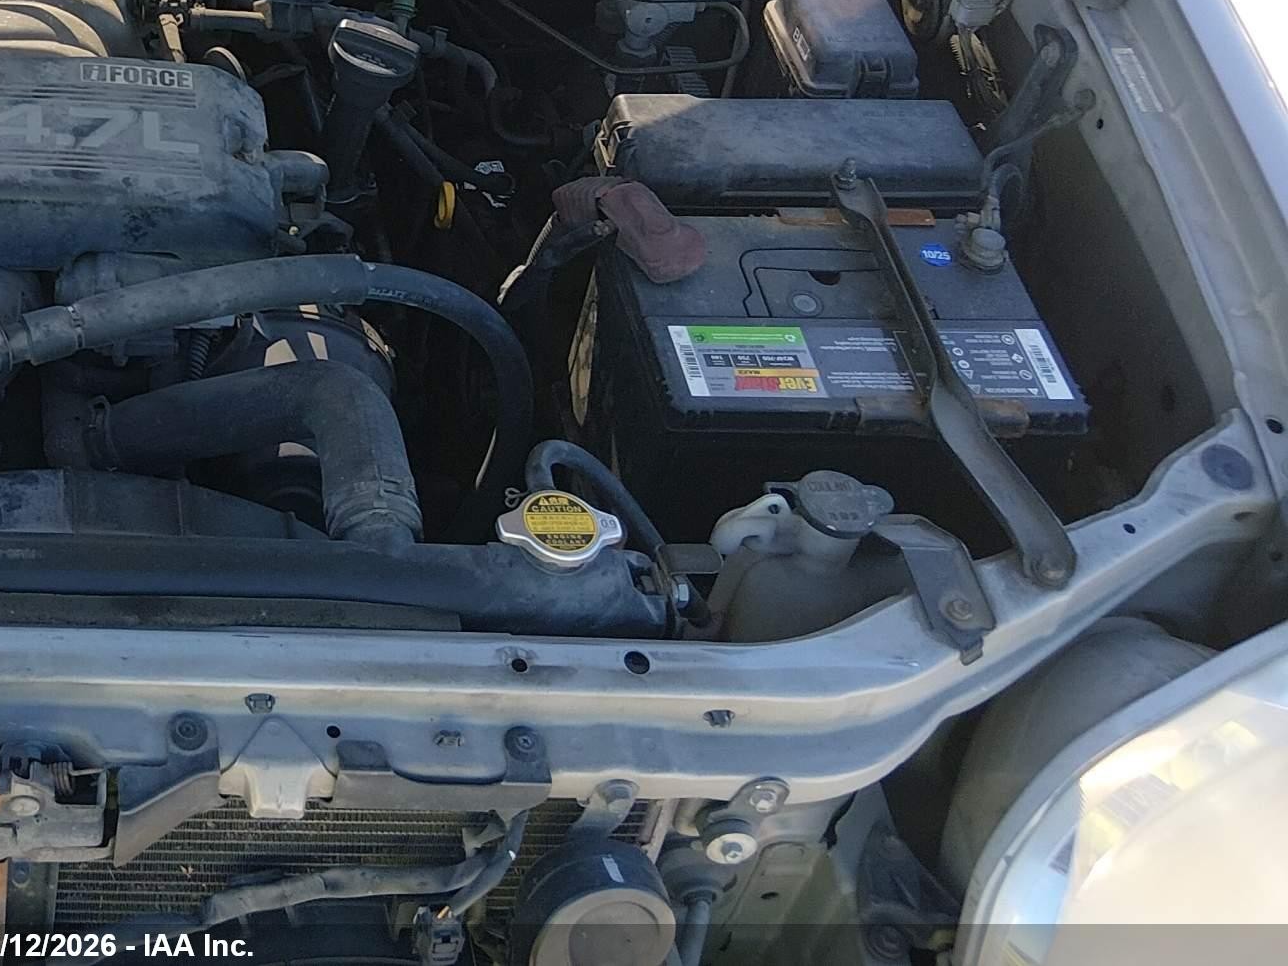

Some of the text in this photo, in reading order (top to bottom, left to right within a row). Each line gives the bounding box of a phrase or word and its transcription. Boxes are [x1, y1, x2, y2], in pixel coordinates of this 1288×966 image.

[921, 249, 952, 261] 10/25
[734, 376, 818, 394] EverStart
[531, 505, 582, 513] CAUTION
